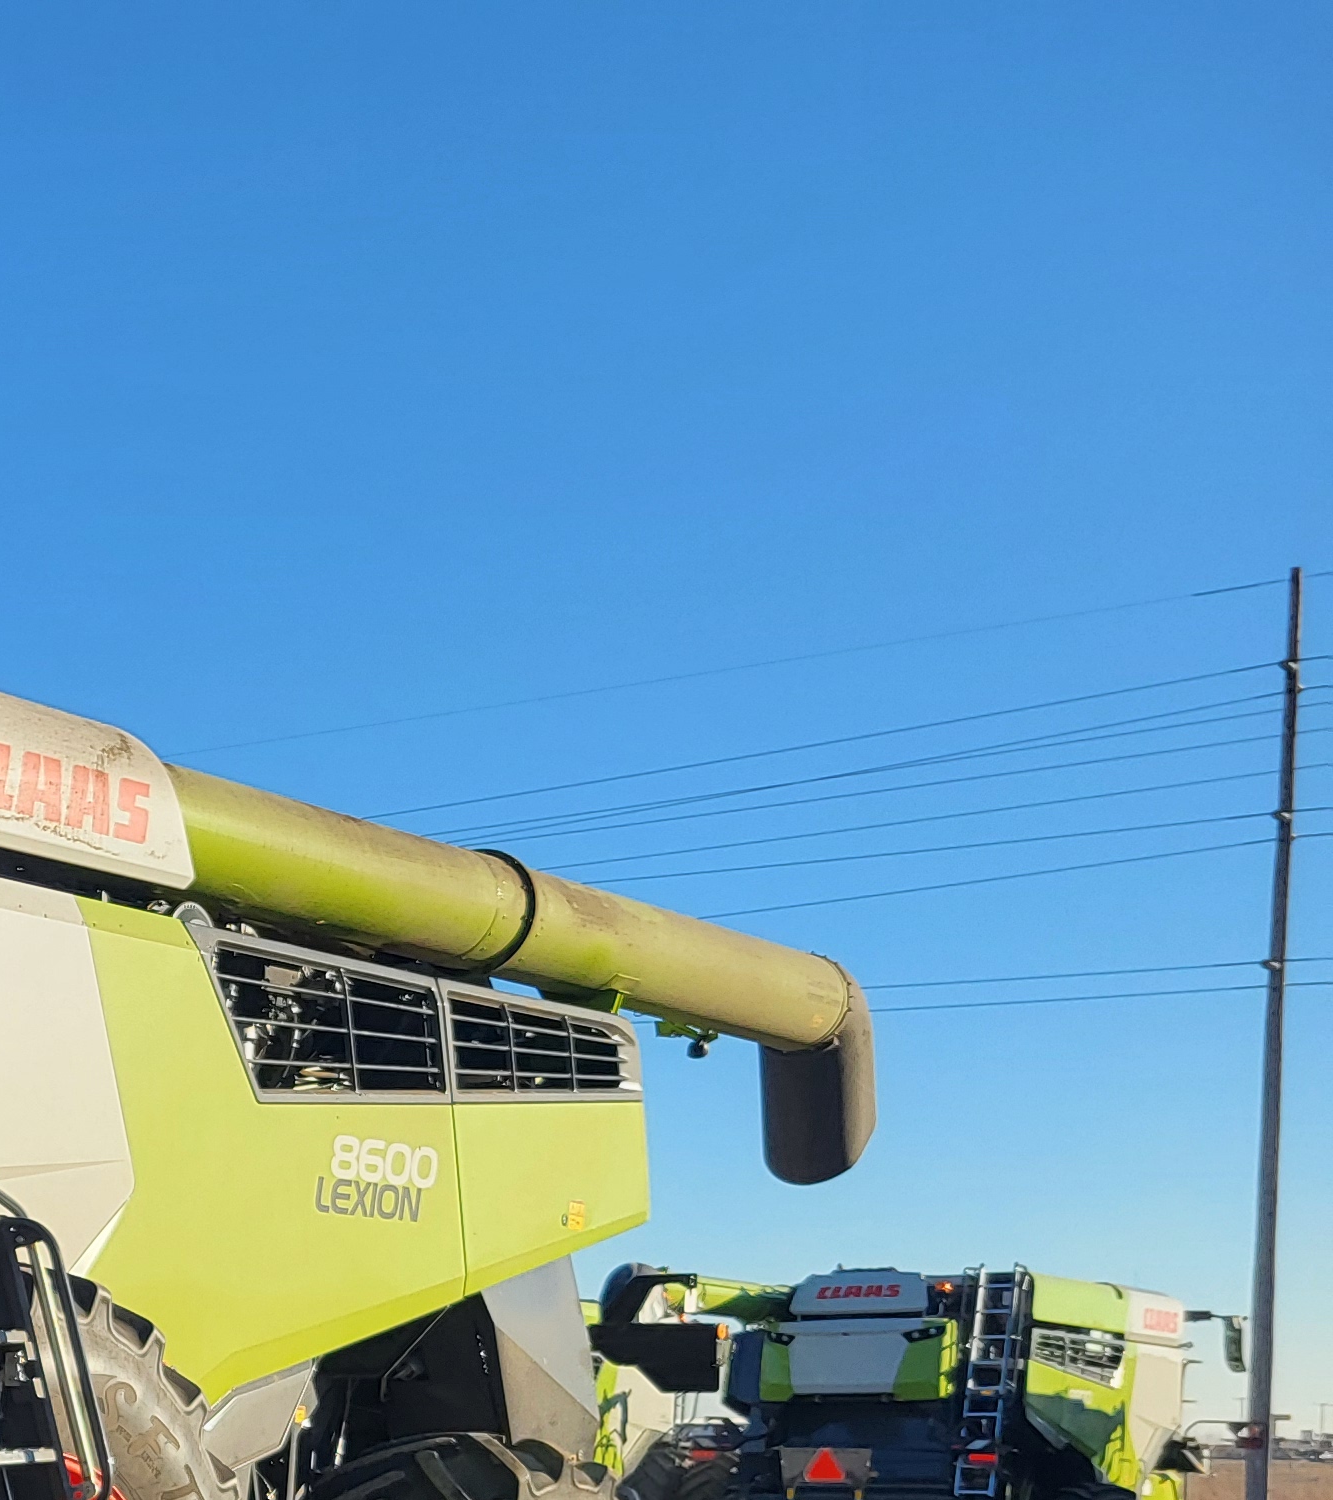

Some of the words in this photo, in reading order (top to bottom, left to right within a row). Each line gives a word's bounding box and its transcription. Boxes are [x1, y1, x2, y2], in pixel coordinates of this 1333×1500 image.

[330, 1134, 439, 1188] 8600
[315, 1175, 422, 1223] LEXION
[816, 1284, 902, 1300] CLAAS
